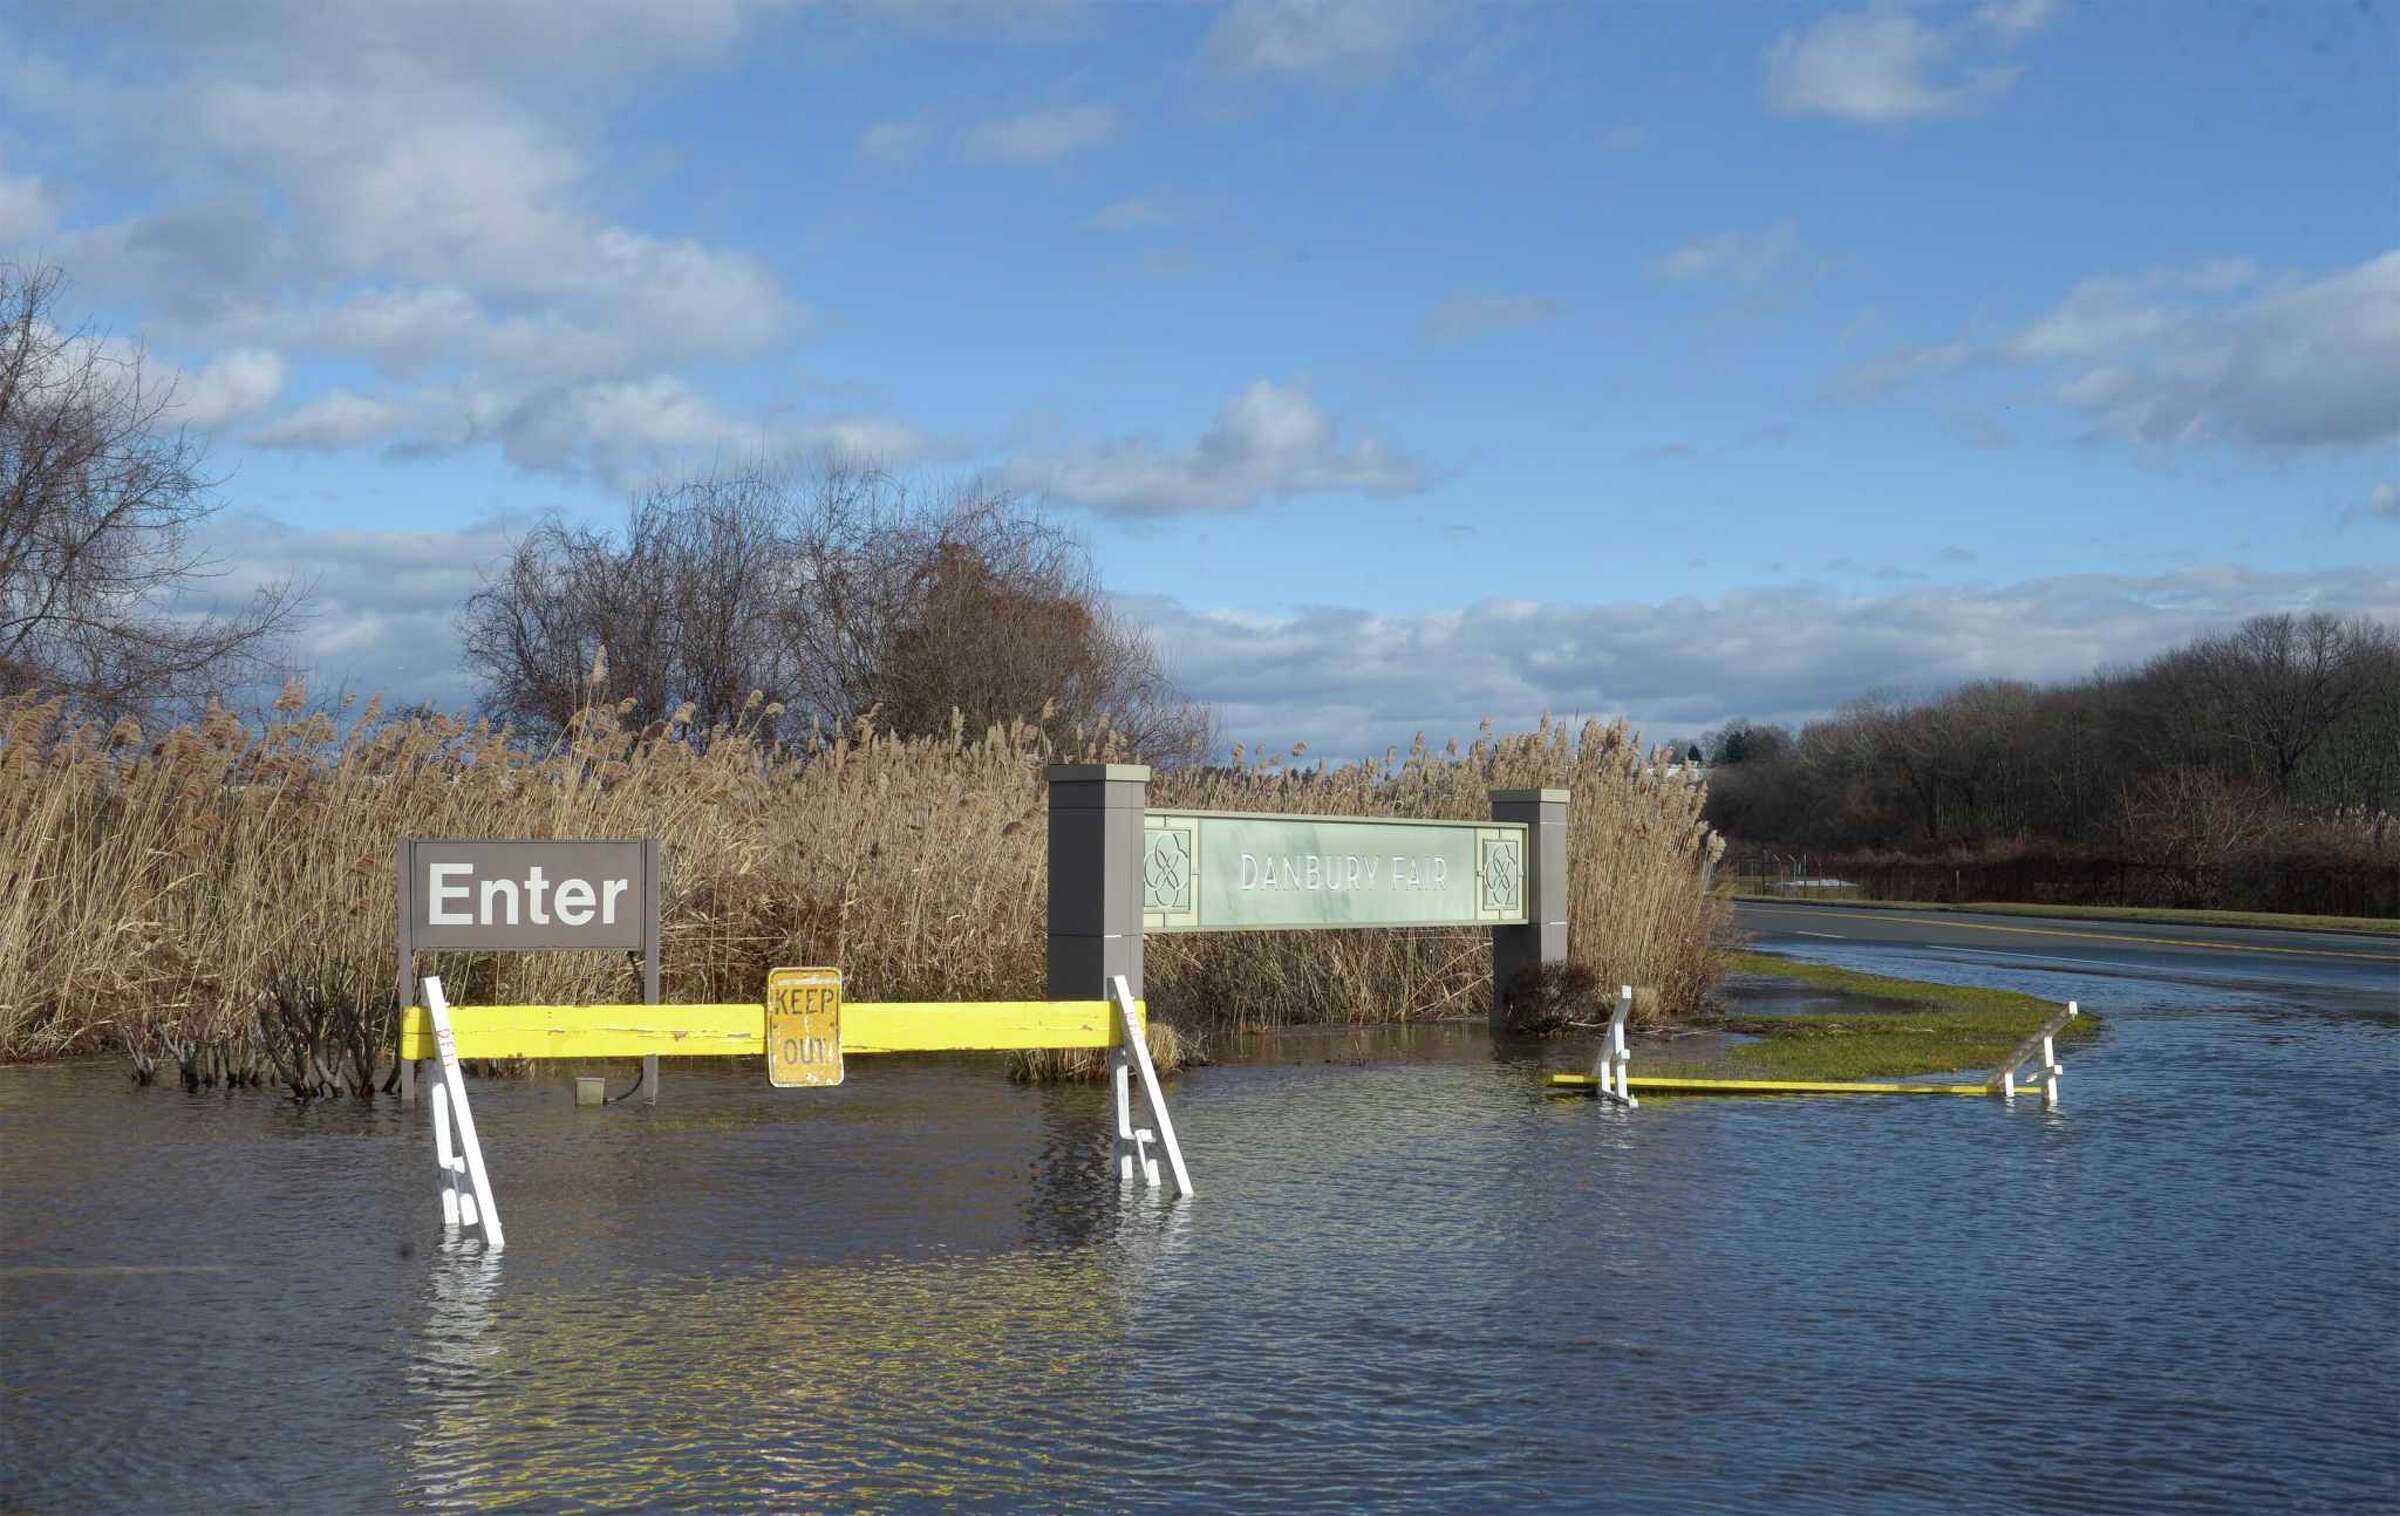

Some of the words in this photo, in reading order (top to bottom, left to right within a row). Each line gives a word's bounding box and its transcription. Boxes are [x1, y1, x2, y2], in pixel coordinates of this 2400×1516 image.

[1240, 854, 1380, 890] DANBURY
[1392, 856, 1448, 890] FAIR
[428, 863, 628, 926] Enter
[775, 988, 834, 1015] KEEP
[784, 1037, 828, 1064] OUT
